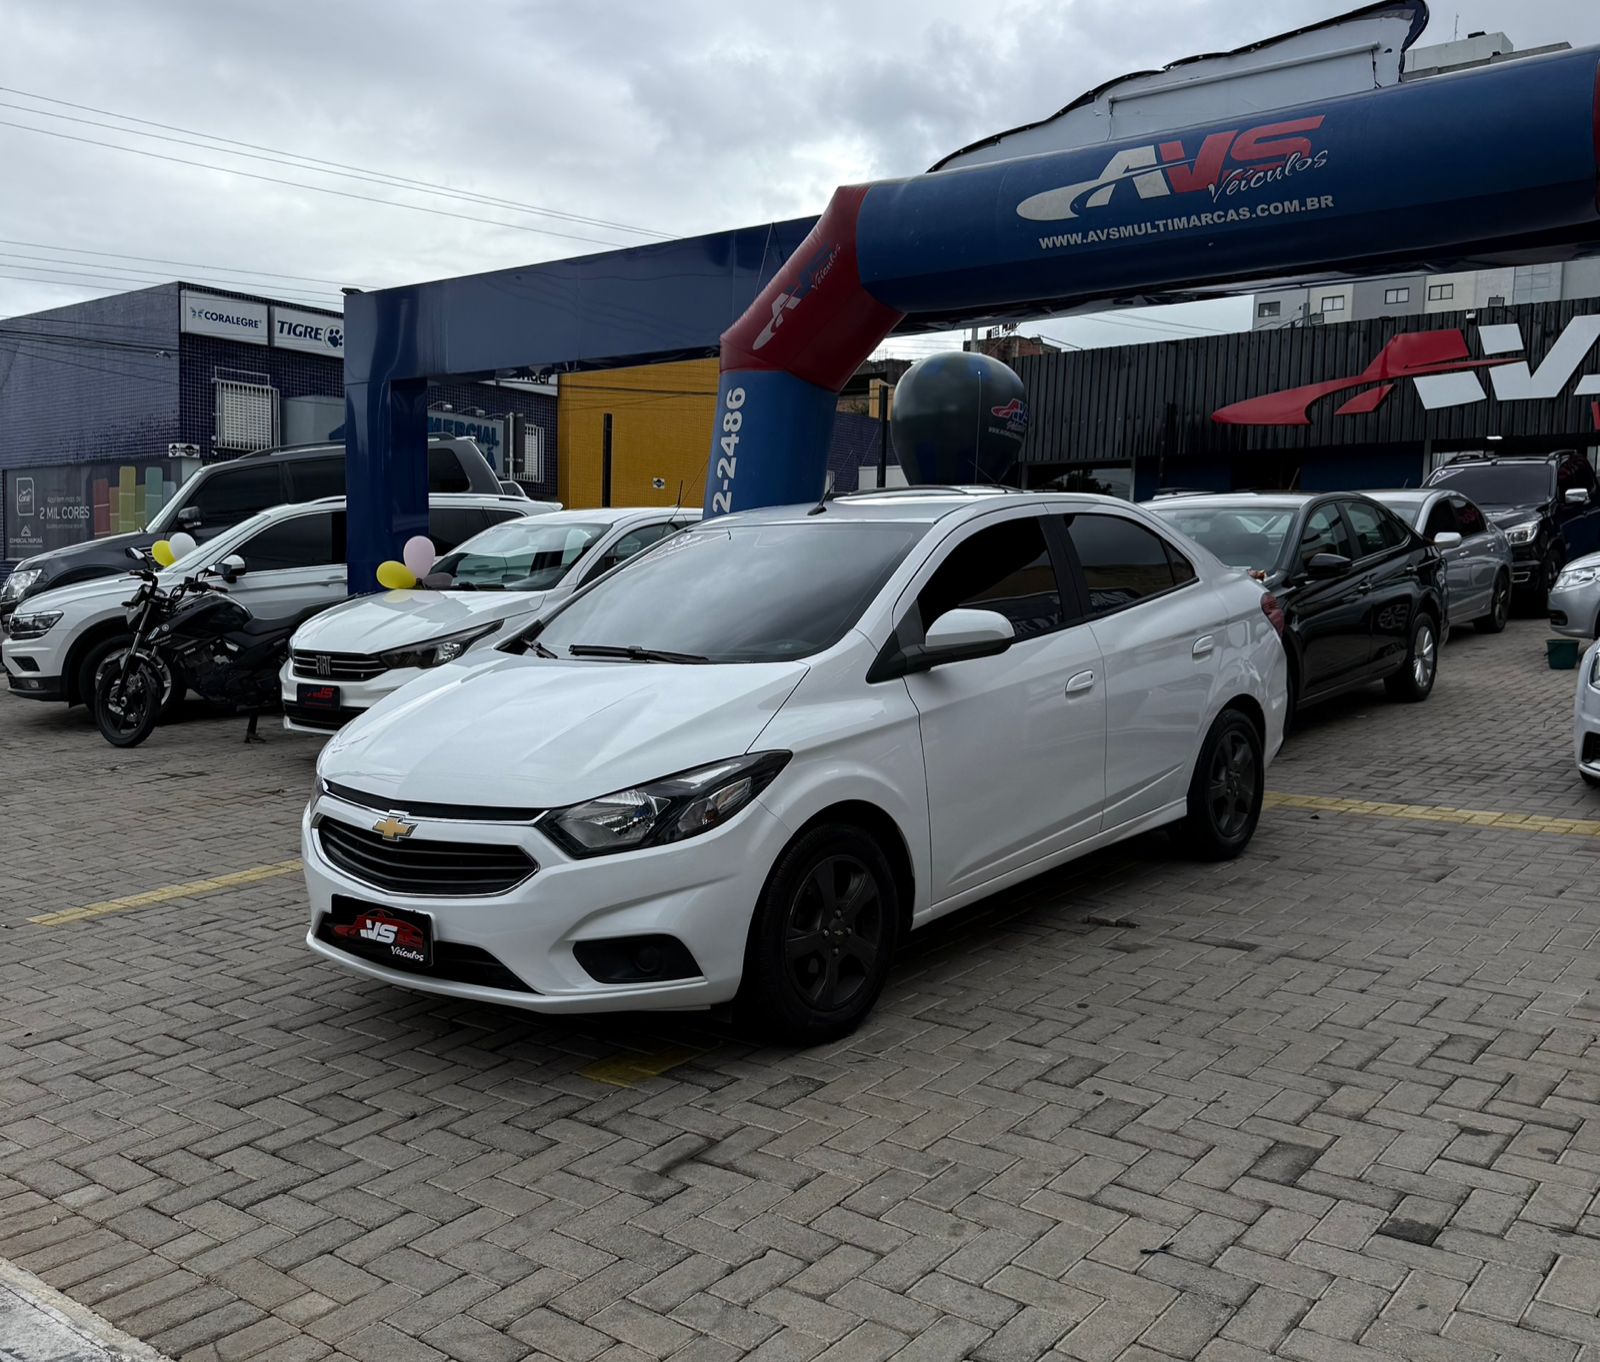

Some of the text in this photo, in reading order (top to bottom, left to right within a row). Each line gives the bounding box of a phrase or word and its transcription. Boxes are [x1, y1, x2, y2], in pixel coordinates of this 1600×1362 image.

[1038, 195, 1334, 249] WWW.AVSMULTIMARCAS.COM.BR
[204, 311, 259, 329] CORALEGRE
[277, 320, 323, 341] TIGRE
[427, 416, 500, 447] MERCIAL
[39, 505, 90, 520] 2 MIL CORES
[315, 655, 331, 675] FIAT
[391, 945, 424, 962] Veículos
